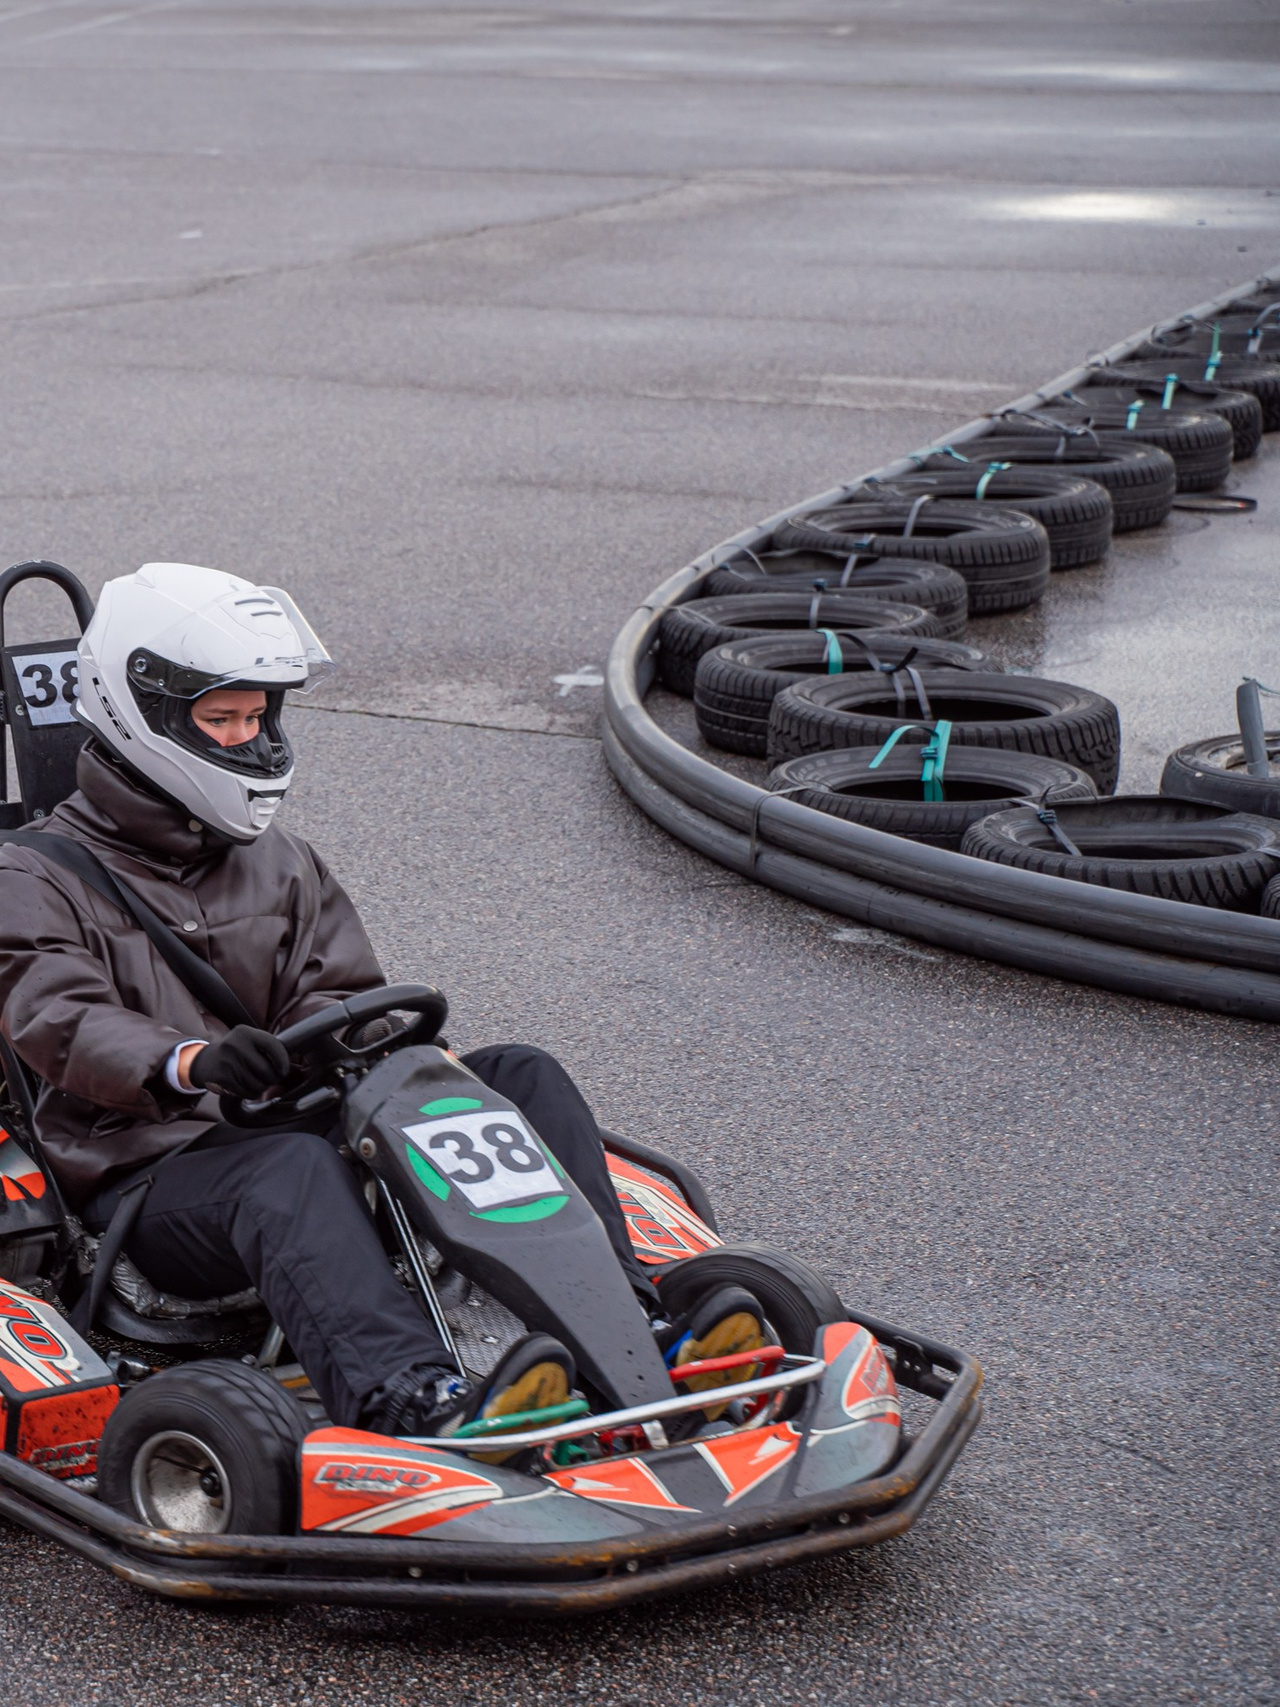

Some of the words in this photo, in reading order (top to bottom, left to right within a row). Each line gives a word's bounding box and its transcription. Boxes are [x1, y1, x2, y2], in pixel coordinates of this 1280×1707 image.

[92, 677, 132, 741] LS2
[429, 1123, 545, 1184] 38
[322, 1463, 432, 1486] DINO
